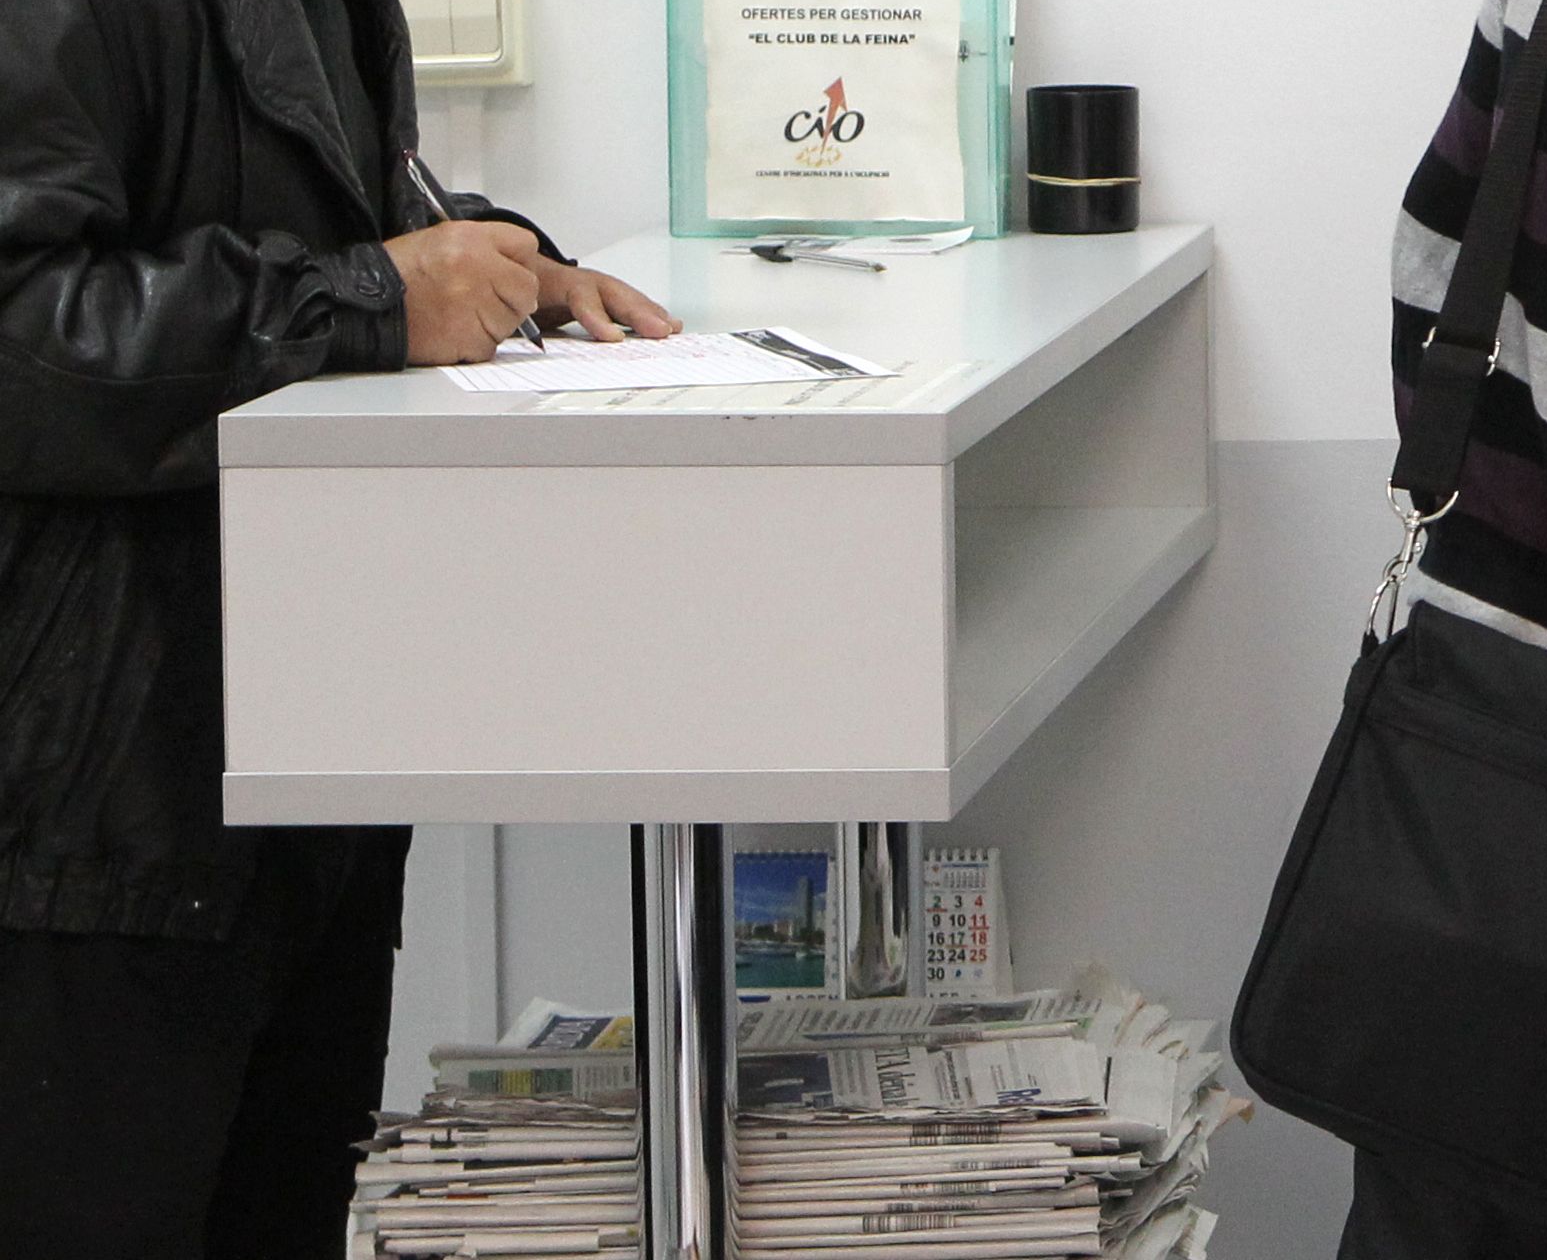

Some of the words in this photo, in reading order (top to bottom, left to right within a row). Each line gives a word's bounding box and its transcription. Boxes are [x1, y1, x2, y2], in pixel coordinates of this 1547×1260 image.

[742, 9, 805, 20] OFERTES
[810, 9, 836, 19] PER
[841, 9, 921, 20] GESTIONAR
[749, 34, 771, 43] “EL
[777, 34, 815, 44] CLUB
[821, 34, 837, 44] DE
[843, 35, 860, 44] LA
[866, 35, 915, 44] FEINA”
[932, 895, 942, 909] 2
[953, 894, 963, 909] 3
[974, 895, 984, 908] 4
[931, 913, 941, 928] 9
[948, 914, 966, 928] 10
[970, 914, 988, 926] 11
[927, 931, 945, 945] 16
[948, 932, 965, 944] 17
[970, 931, 988, 945] 18
[927, 949, 946, 963] 23
[947, 949, 966, 963] 24
[969, 949, 988, 963] 25
[927, 967, 945, 981] 30
